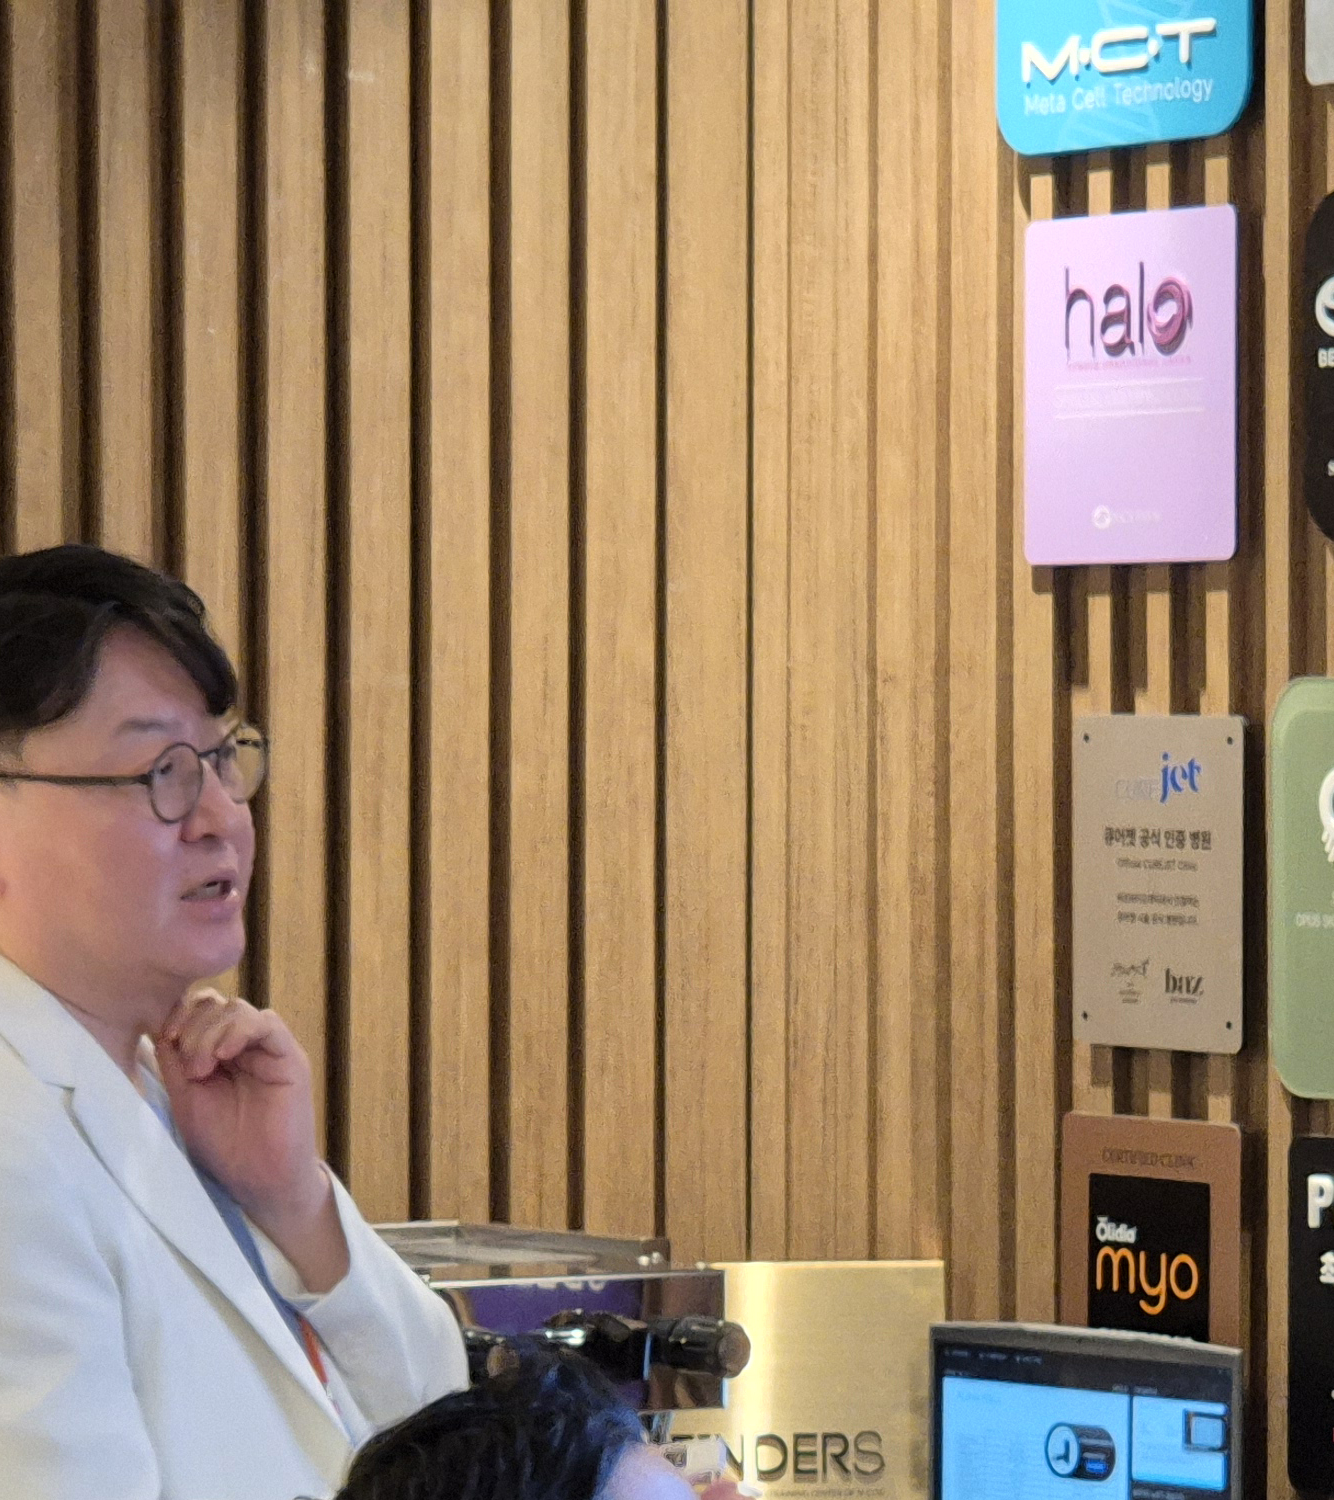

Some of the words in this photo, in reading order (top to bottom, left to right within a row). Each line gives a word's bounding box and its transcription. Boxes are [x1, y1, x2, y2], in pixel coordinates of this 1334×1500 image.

[1024, 93, 1066, 116] Meta
[1072, 86, 1106, 111] Cell
[1114, 77, 1213, 106] Technology
[1064, 261, 1194, 358] halo
[1095, 1246, 1199, 1316] myo
[672, 1430, 886, 1479] NDERS
